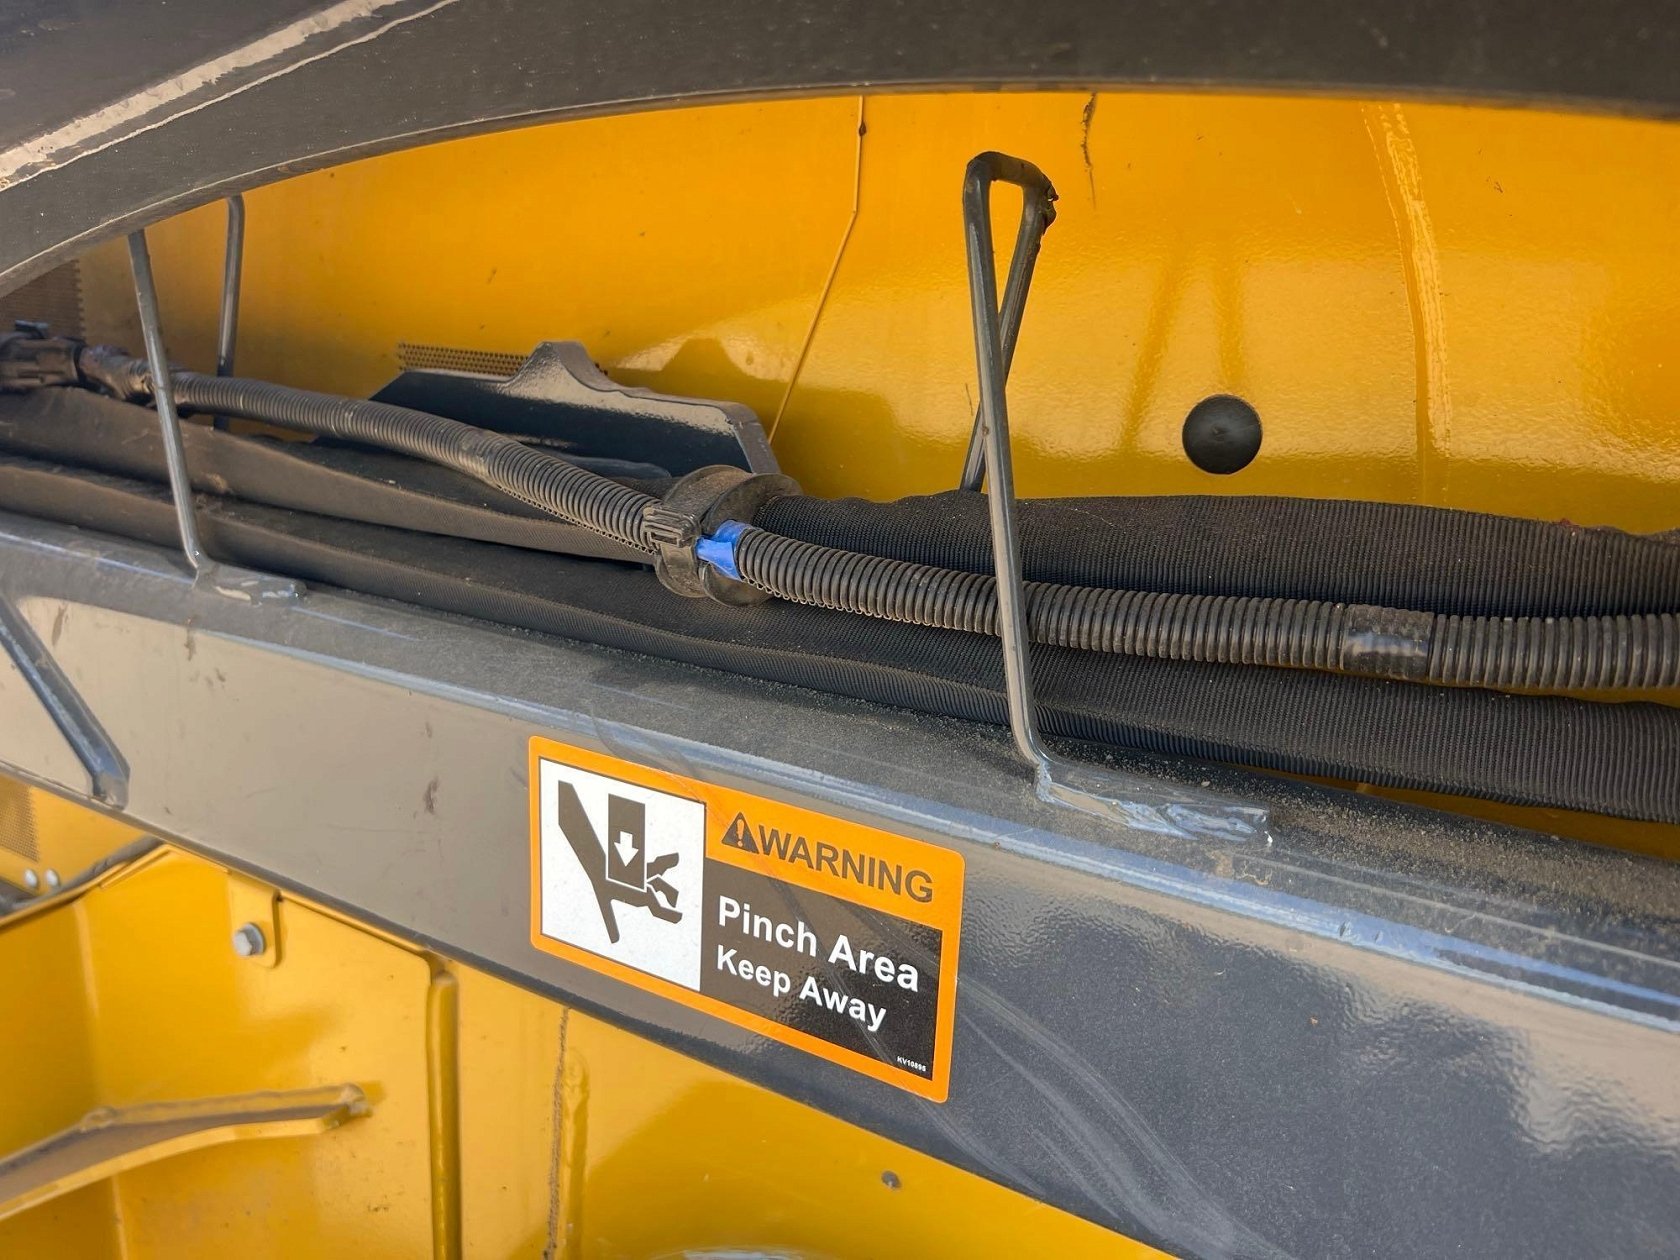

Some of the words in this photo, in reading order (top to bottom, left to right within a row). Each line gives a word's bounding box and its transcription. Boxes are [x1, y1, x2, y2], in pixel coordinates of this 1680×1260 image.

[758, 825, 933, 903] WARNING
[718, 895, 817, 957] Pinch
[828, 935, 919, 992] Area
[717, 945, 791, 998] Keep
[799, 977, 887, 1032] Away
